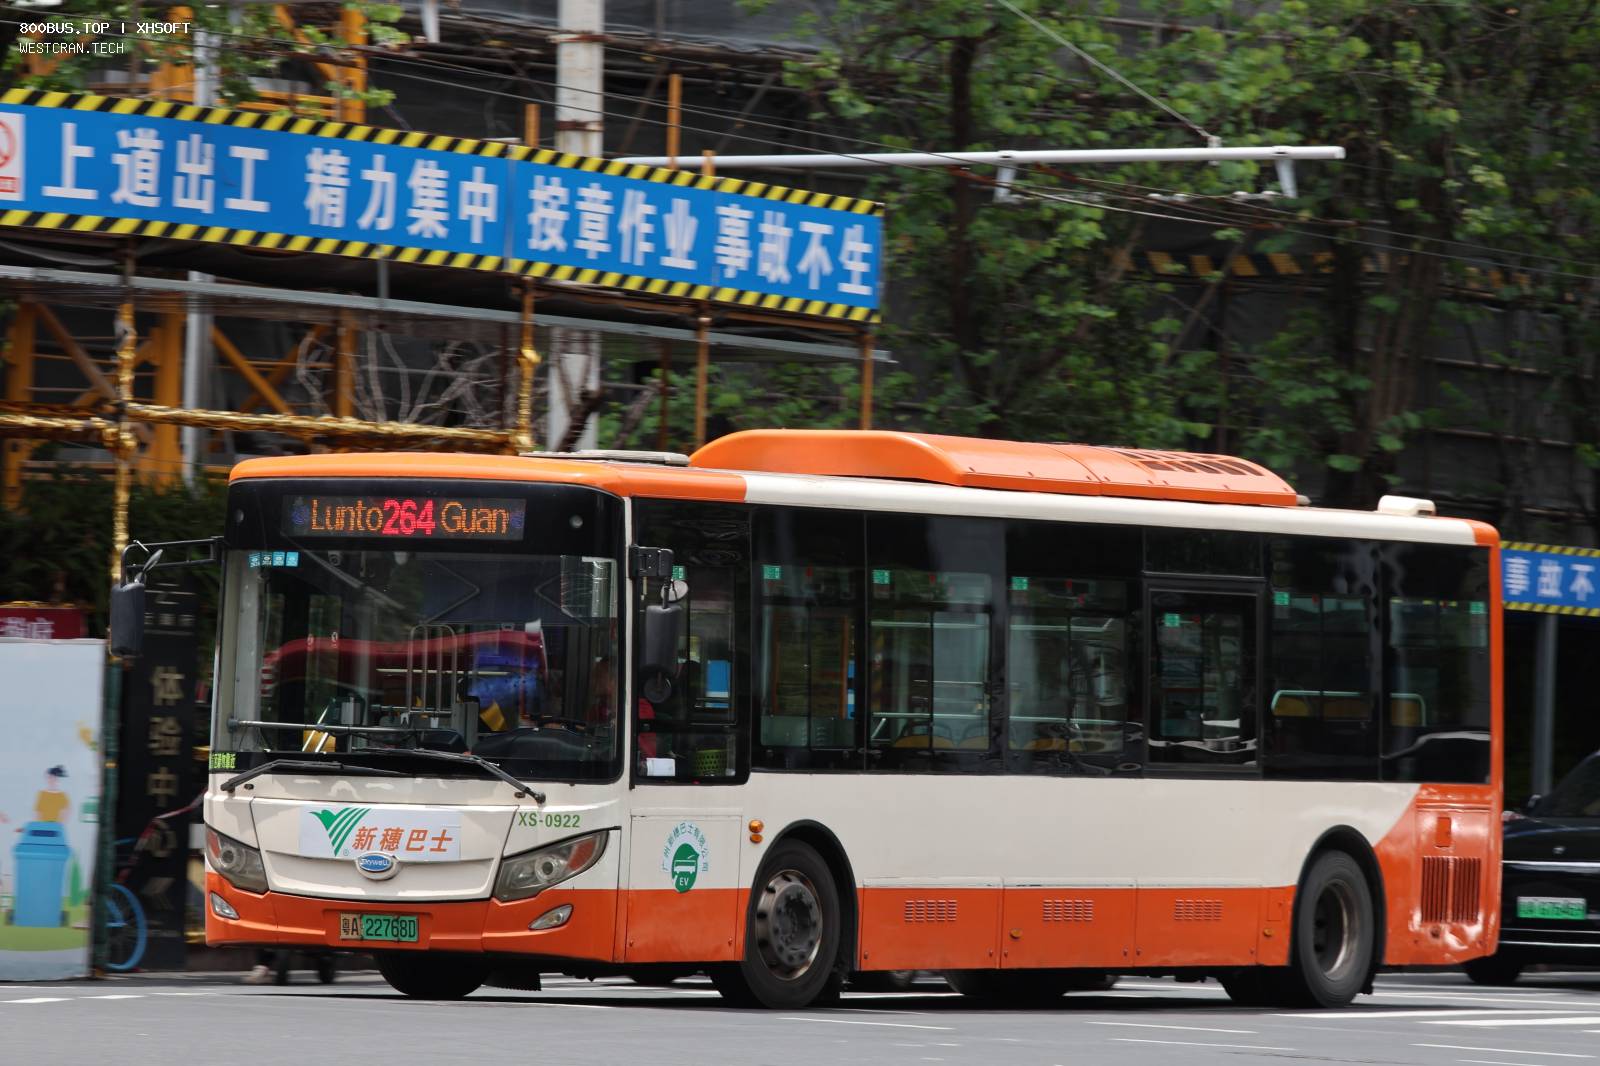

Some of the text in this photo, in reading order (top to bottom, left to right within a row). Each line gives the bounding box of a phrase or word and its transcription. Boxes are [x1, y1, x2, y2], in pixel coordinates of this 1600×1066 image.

[41, 122, 873, 296] 上道出工 精力集中 按章作业 事故不生
[312, 499, 510, 535] Lunto 264 Guan
[518, 812, 581, 828] XS-0922
[351, 826, 453, 852] 新穗巴士
[679, 877, 689, 886] EV
